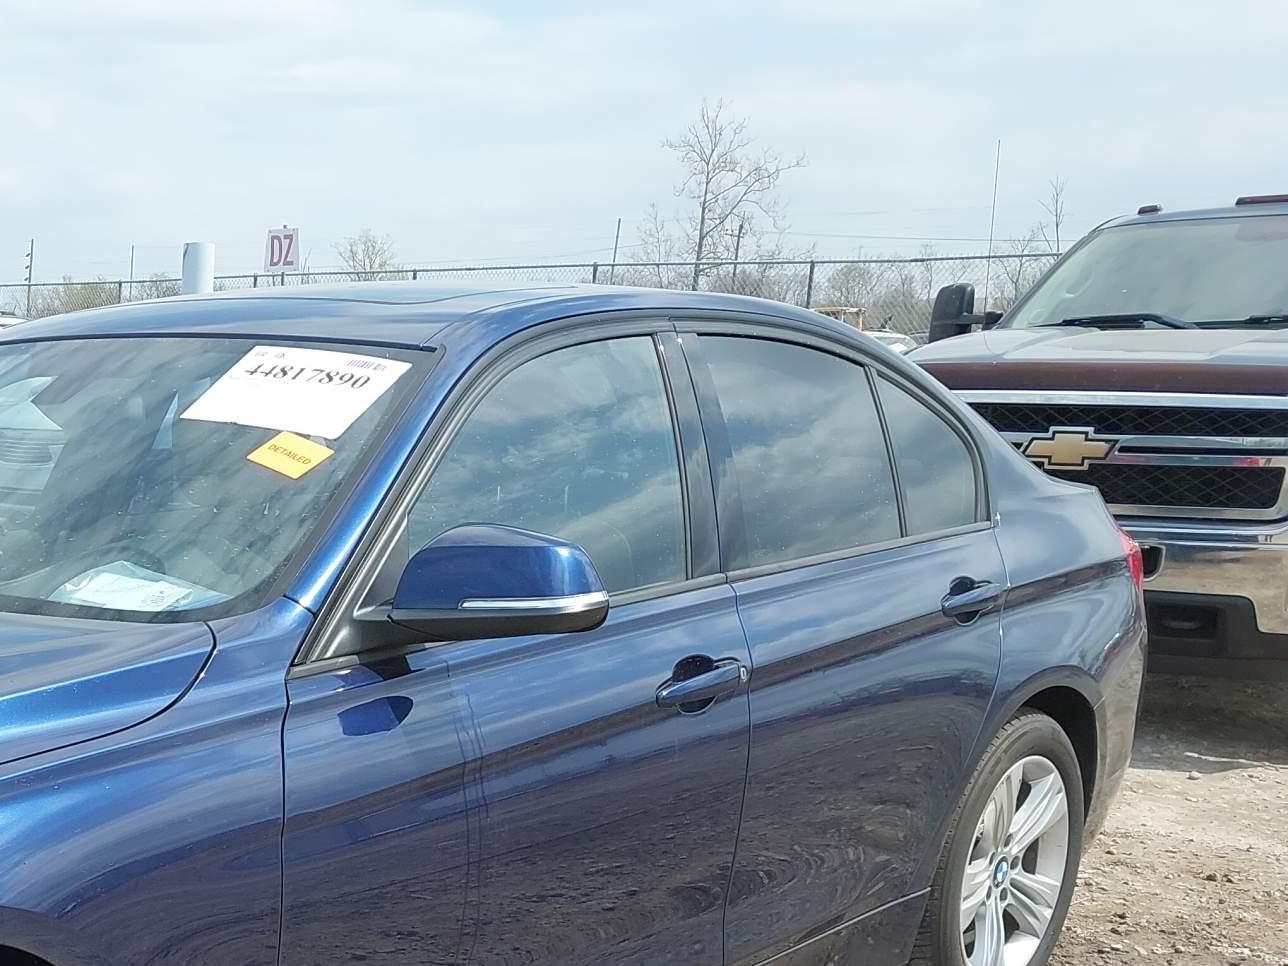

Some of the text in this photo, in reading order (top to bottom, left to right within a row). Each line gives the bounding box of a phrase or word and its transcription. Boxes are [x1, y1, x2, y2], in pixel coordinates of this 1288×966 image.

[269, 233, 294, 267] DZ
[244, 362, 372, 390] 44817890
[267, 443, 312, 466] DETAILED
